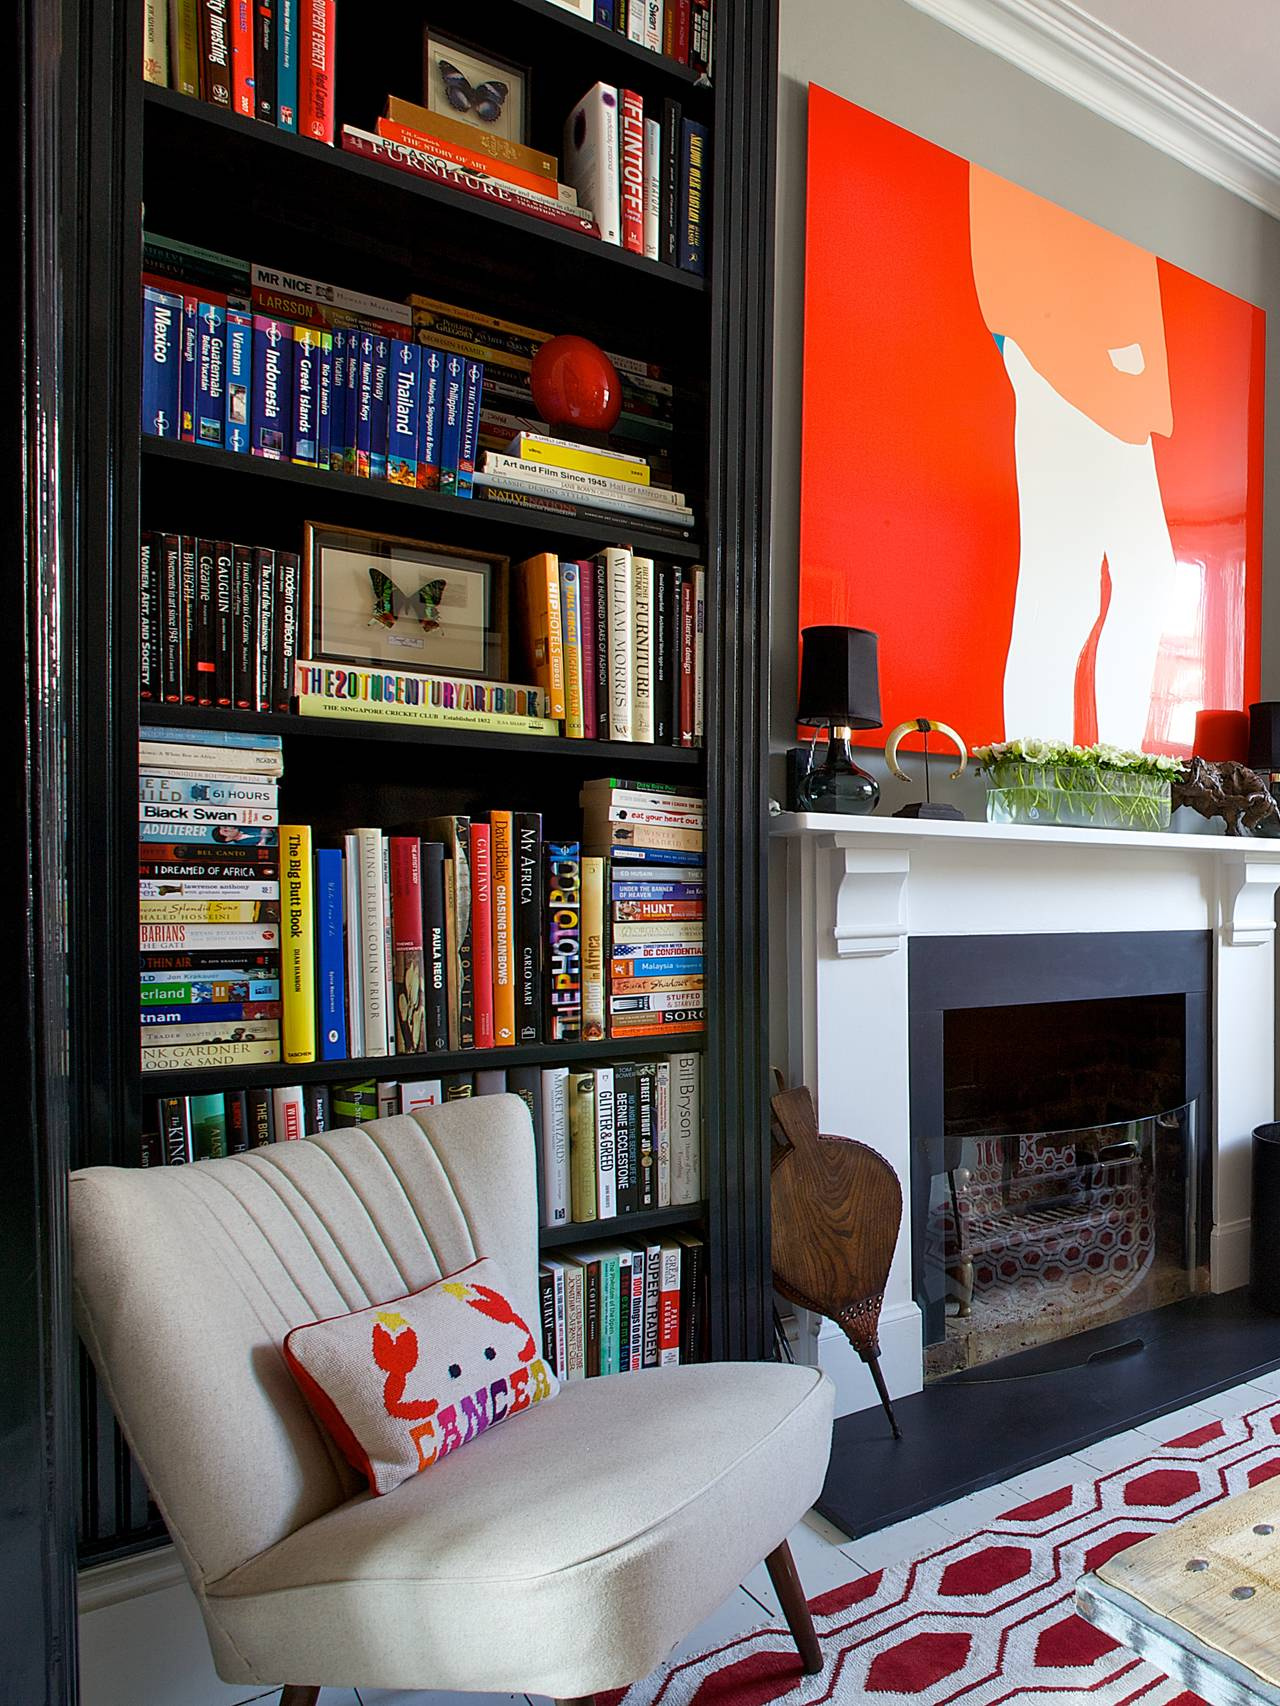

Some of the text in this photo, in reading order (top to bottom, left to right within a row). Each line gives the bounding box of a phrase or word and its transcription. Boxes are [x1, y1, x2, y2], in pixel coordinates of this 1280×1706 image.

[651, 3, 660, 31] Swan
[208, 13, 227, 67] Investing
[312, 31, 325, 71] EVERETT
[371, 140, 513, 203] FURNITURE
[382, 139, 449, 173] PICASSO
[401, 135, 488, 171] THE STORY OF ART
[624, 100, 643, 217] FLINTOFF
[257, 270, 313, 295] MR NICE
[258, 293, 314, 319] LARSSON
[153, 306, 172, 364] Mexico
[185, 327, 194, 362] Edinburgh
[231, 332, 244, 376] Vietnam
[209, 338, 223, 398] Guatemala
[265, 350, 281, 418] Indonesia
[373, 364, 386, 401] Norway
[299, 359, 312, 433] Greek Islands
[396, 369, 415, 435] Thailand
[447, 382, 459, 426] Philippines
[463, 385, 477, 459] THE ITALIAN LAKES
[488, 488, 529, 504] NATIVE
[503, 459, 669, 502] Art and Film Since 1945 Hall of Mirrors
[183, 552, 194, 602] BRUEGEL
[199, 555, 213, 601] Cézanne
[217, 556, 232, 613] GAUGUIN
[261, 579, 272, 592] Art
[262, 564, 272, 579] The
[284, 566, 295, 603] modern
[140, 545, 151, 685] WOMEN, ART, AND SOCIETY
[242, 562, 252, 645] From Giotto to Cézanne
[261, 598, 271, 610] the
[549, 582, 559, 610] HIP
[260, 611, 271, 651] Renaissance
[282, 605, 293, 657] architecture
[550, 611, 561, 653] HOTELS
[597, 565, 608, 686] FOUR HUNDRED YEARS OF FASHION
[613, 557, 627, 708] WILLIAM MORRIS
[684, 614, 693, 646] Interior
[565, 586, 580, 717] FULL CIRCLE MICHAEL PALIN
[635, 601, 650, 698] FURNITURE
[683, 646, 693, 674] design
[322, 703, 339, 712] THE
[340, 705, 383, 716] SINGAPORE
[384, 707, 417, 718] CRICKET
[418, 711, 439, 720] CLUB
[443, 714, 476, 723] Established
[143, 806, 237, 822] Black Swan
[212, 790, 270, 801] 61 HOURS
[143, 824, 207, 837] ADULTERER
[646, 814, 664, 823] your
[664, 815, 684, 824] heart
[287, 834, 300, 857] The
[154, 866, 255, 877] I DREAMED OF AFRICA
[287, 859, 301, 878] Big
[476, 837, 488, 903] GALLIANO
[290, 881, 301, 906] Butt
[496, 884, 507, 930] CHASING
[643, 903, 674, 914] HUNT
[290, 909, 302, 938] Book
[365, 836, 380, 1020] LIVING TRIBES COLIN PRIOR
[520, 828, 536, 1006] MY AFRICA CARLO MARI
[147, 956, 192, 969] THIN AIR
[432, 927, 442, 989] PAULA REGO
[497, 931, 508, 985] RAINBOWS
[666, 993, 701, 1001] STUFFED
[172, 1043, 251, 1059] GARDNER
[183, 1058, 194, 1068] &
[198, 1055, 235, 1066] SAND
[316, 1098, 324, 1120] Racing
[554, 1073, 565, 1165] MARKET WIZARDS
[640, 1077, 651, 1153] STREET WITHOUT JOY
[678, 1057, 694, 1139] Bill Bryson
[256, 1102, 267, 1139] THE BIG
[616, 1092, 629, 1190] BERNIE ECCLESTONE
[668, 1255, 676, 1285] GREAT
[542, 1287, 554, 1329] SEURAT
[632, 1276, 642, 1354] 1000 things to do in
[646, 1253, 660, 1358] SUPER TRADER
[409, 1358, 551, 1472] CANCER
